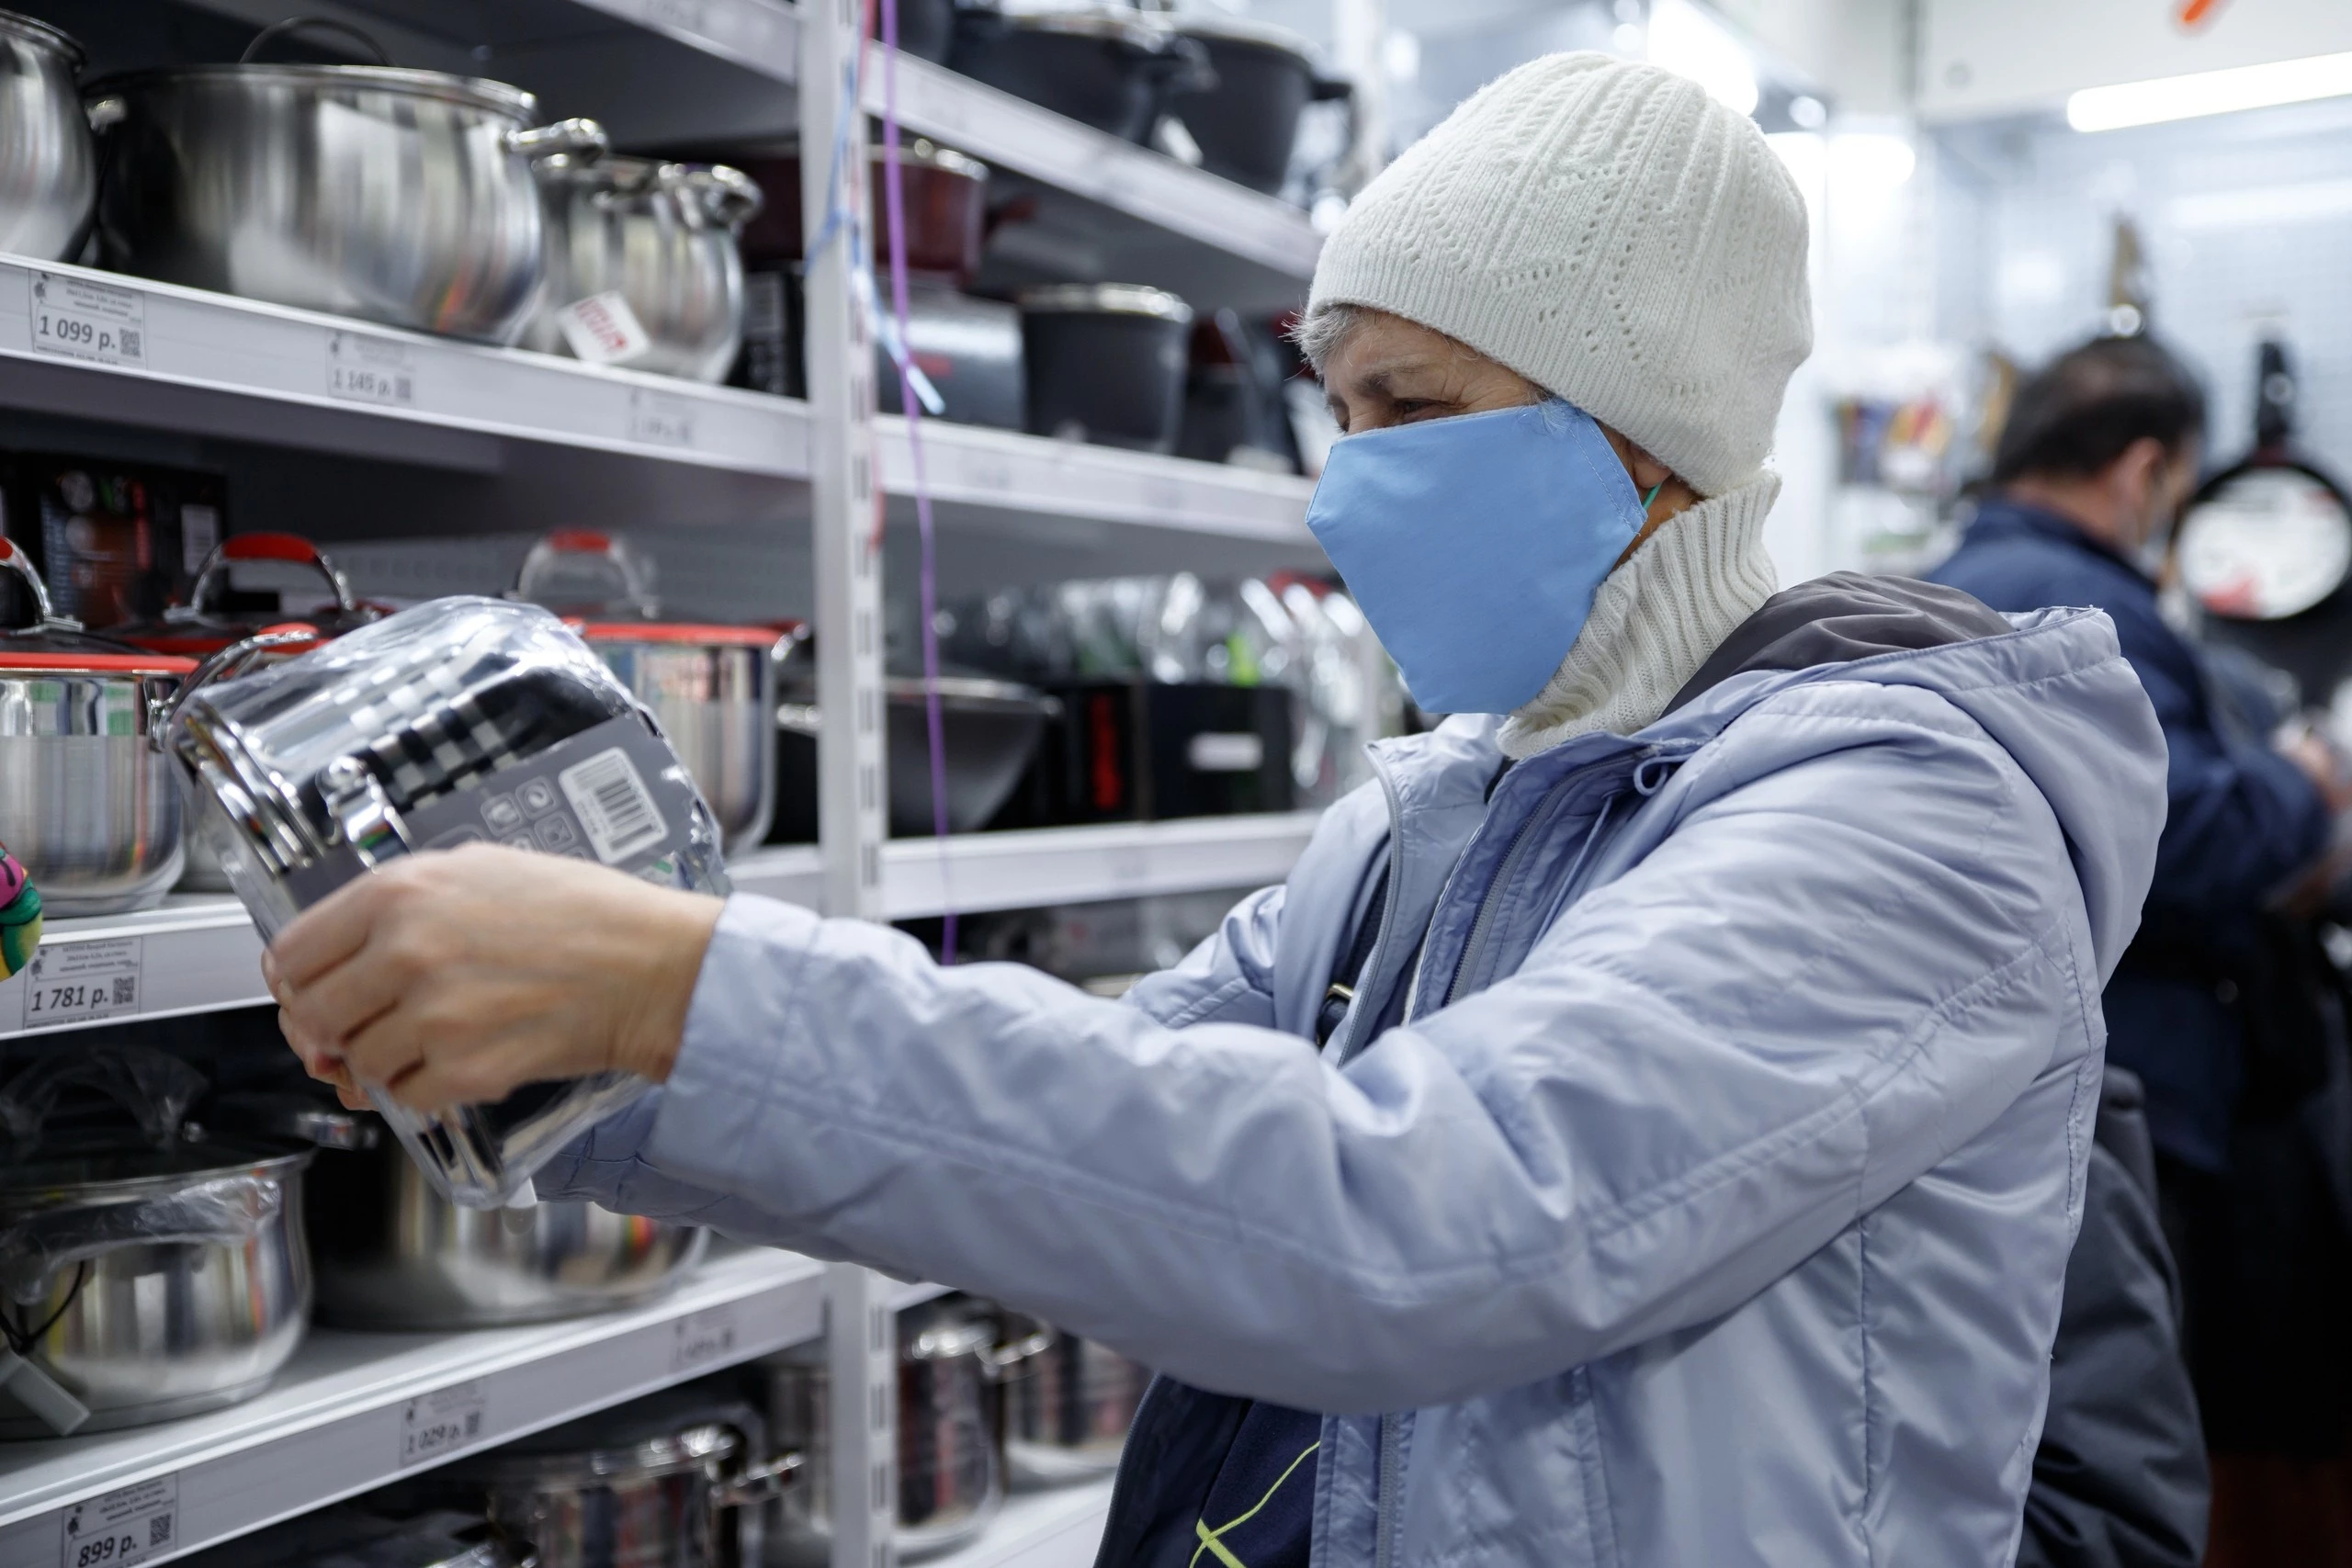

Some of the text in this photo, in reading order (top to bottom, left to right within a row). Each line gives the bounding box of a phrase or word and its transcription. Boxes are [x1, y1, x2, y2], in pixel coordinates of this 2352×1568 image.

[56, 318, 94, 344] 099
[50, 985, 85, 1010] 781
[77, 1536, 115, 1568] 899
